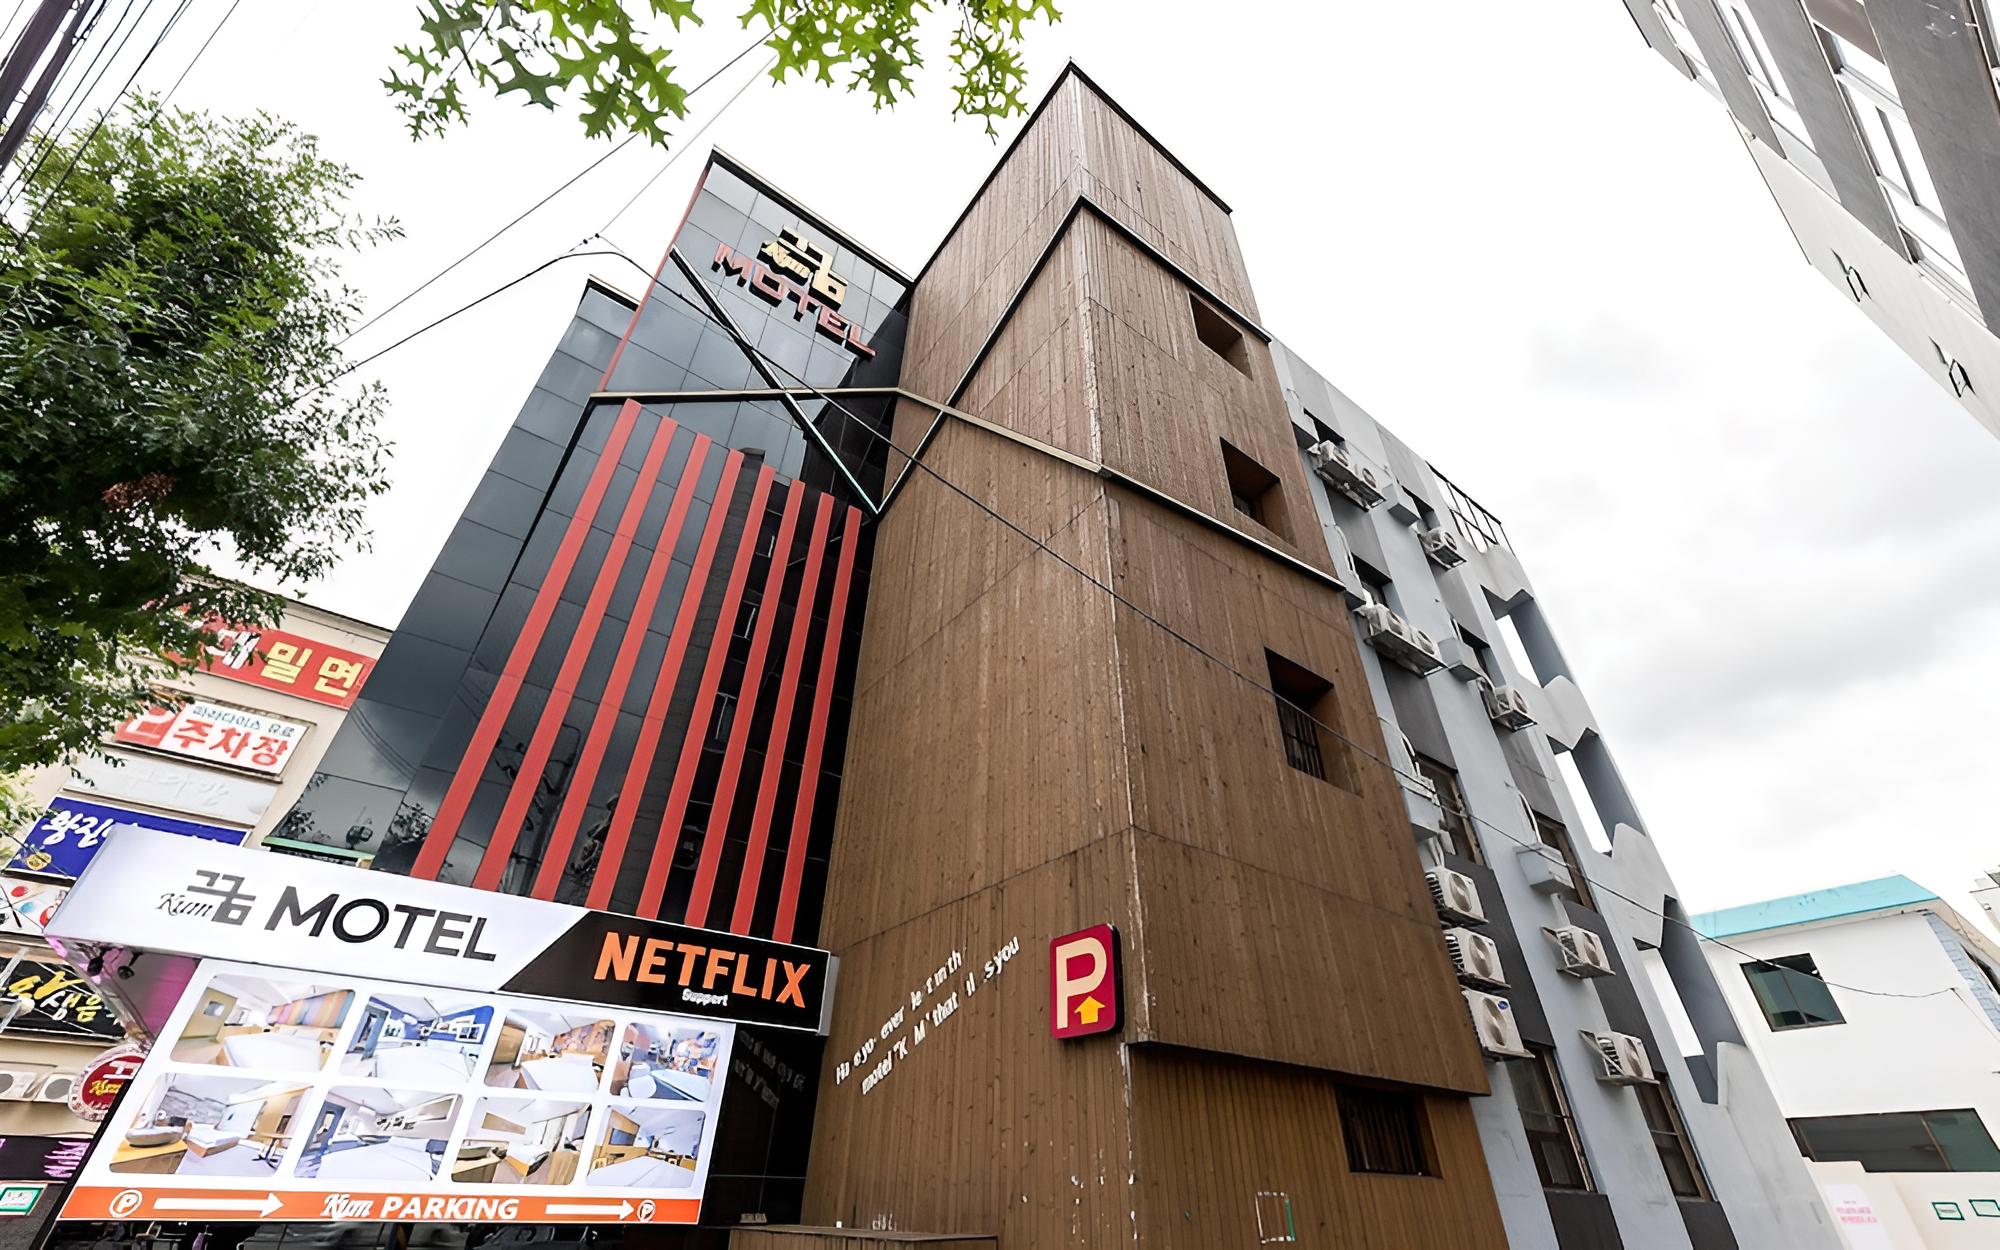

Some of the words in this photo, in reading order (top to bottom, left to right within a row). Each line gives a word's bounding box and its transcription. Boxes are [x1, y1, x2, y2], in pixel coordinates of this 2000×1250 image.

[711, 242, 876, 361] MOTEL
[173, 718, 288, 767] 주차장
[187, 870, 257, 926] 꿈
[264, 886, 496, 962] MOTEL
[594, 931, 811, 1009] NETFLIX
[1056, 937, 1107, 1029] P
[380, 1196, 519, 1220] PARKING
